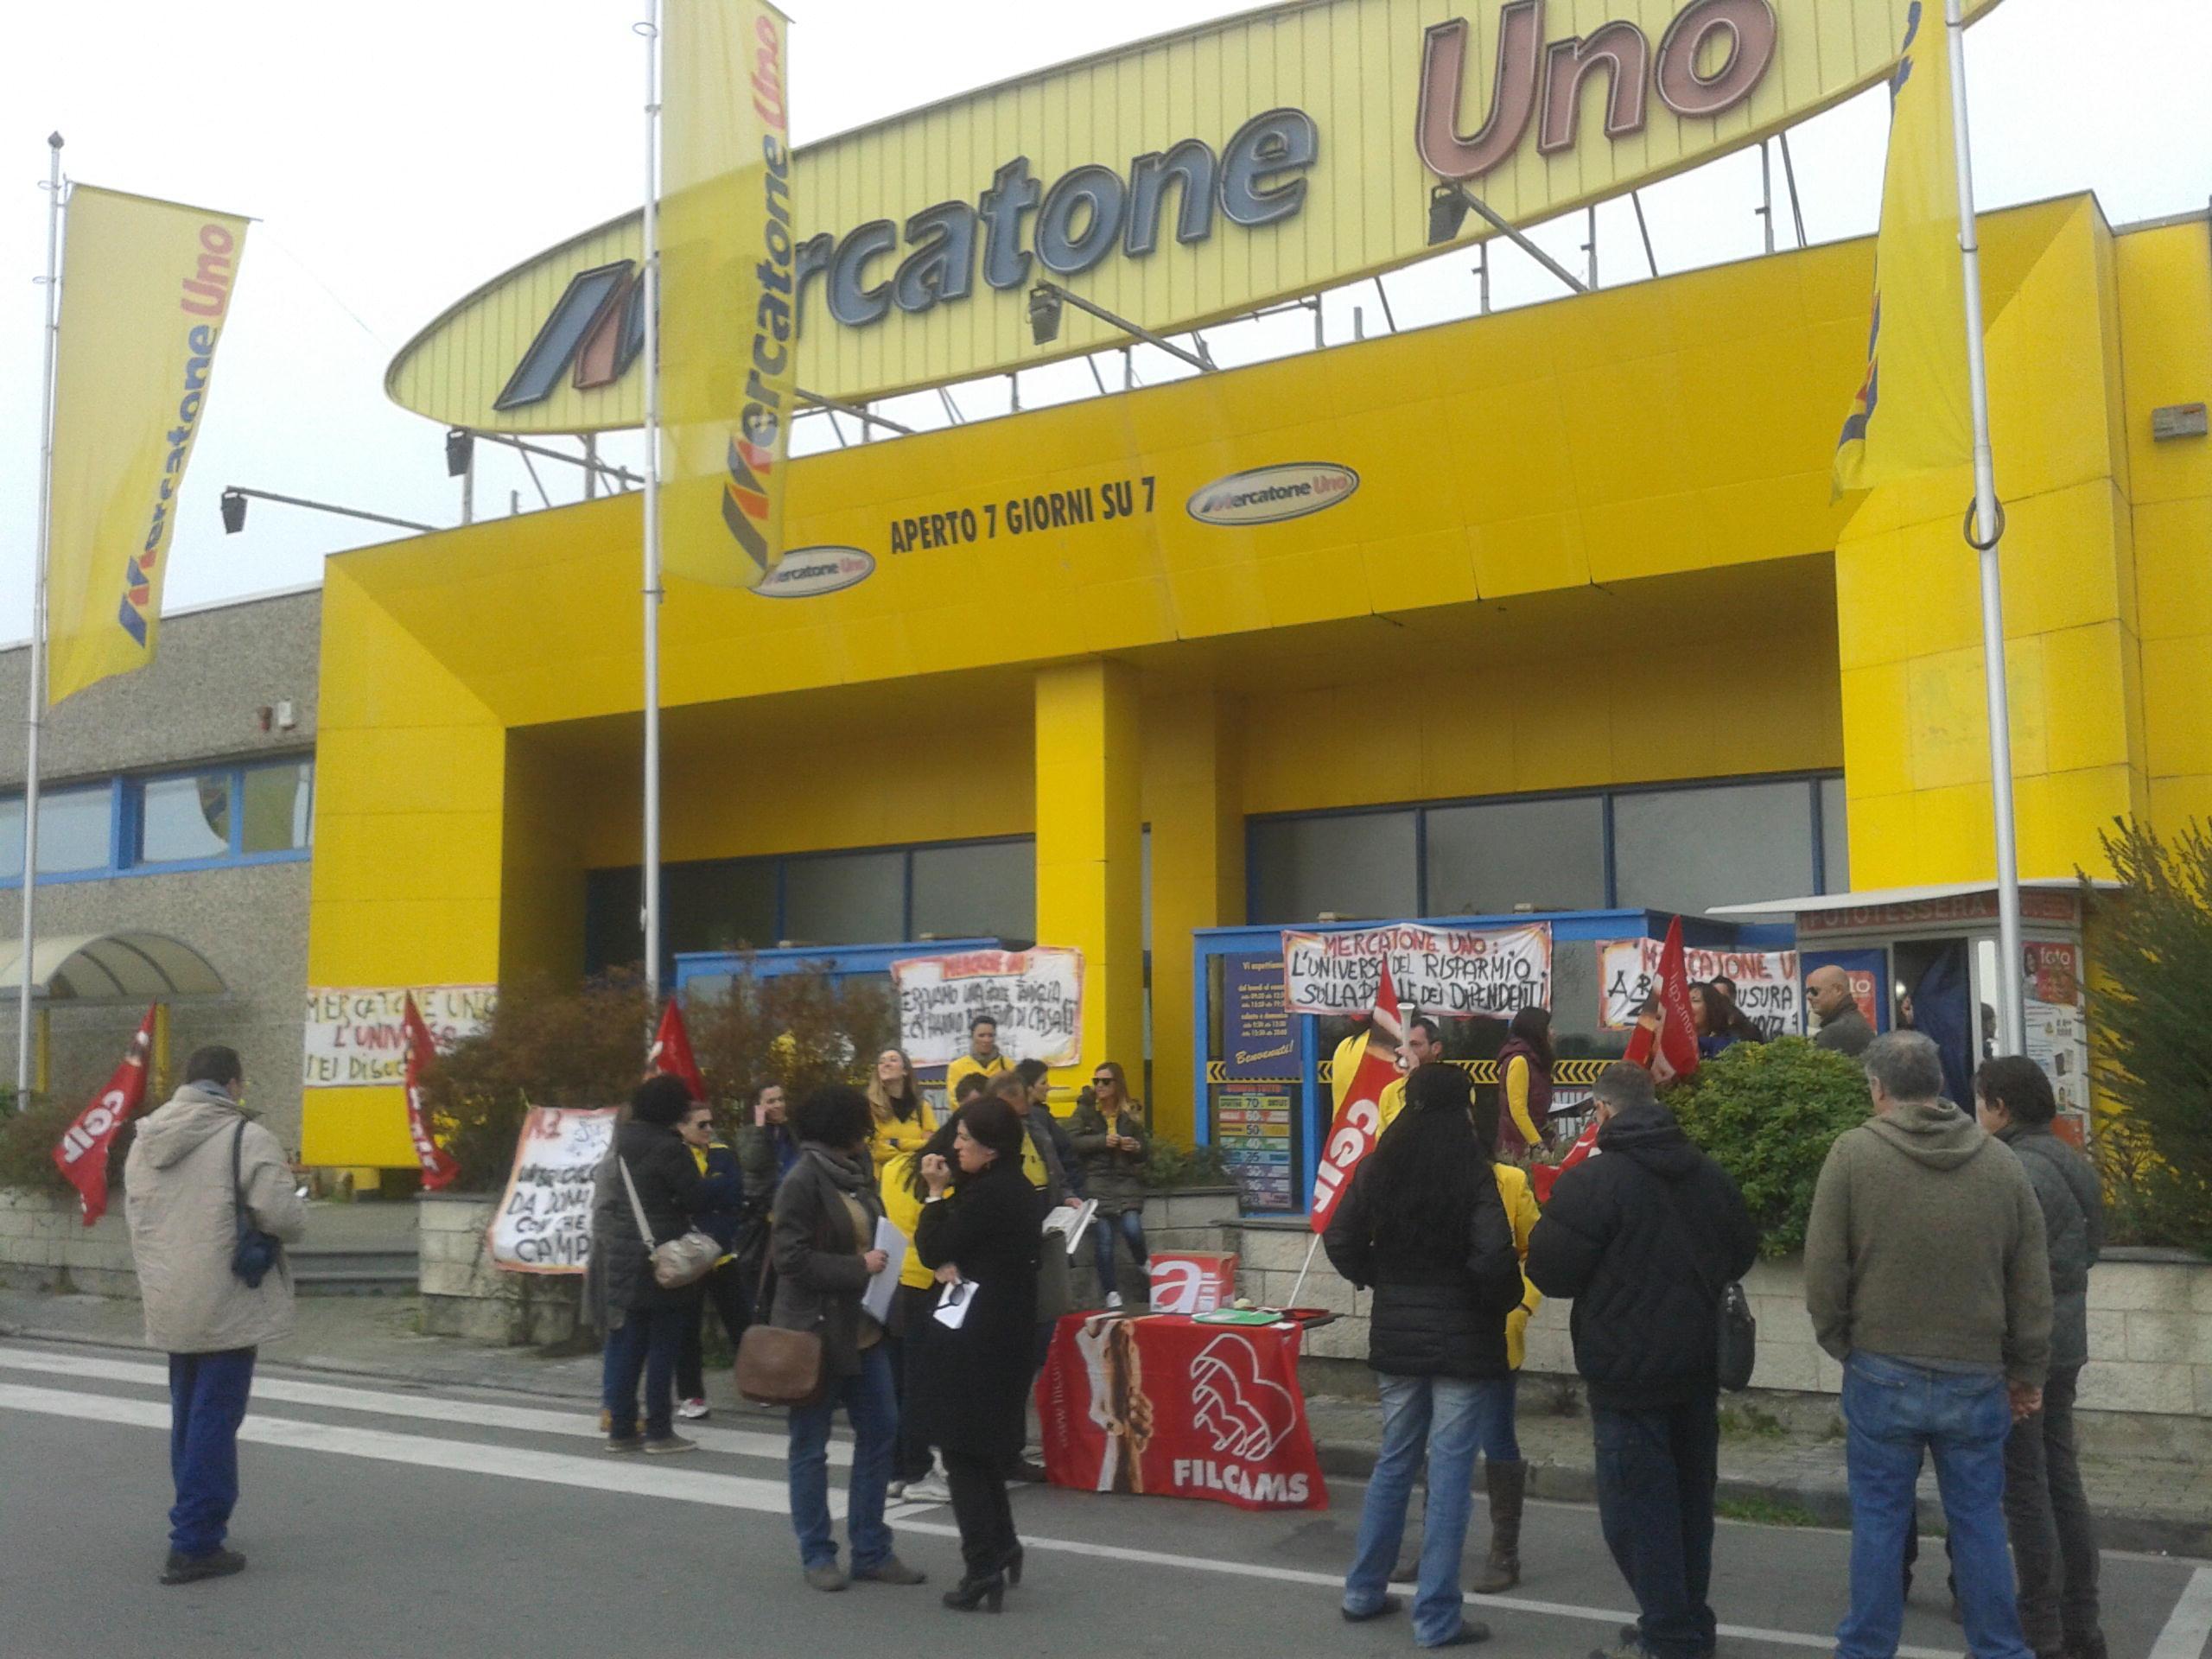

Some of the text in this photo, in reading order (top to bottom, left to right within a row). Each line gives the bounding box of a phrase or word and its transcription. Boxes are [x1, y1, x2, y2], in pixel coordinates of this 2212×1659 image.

[493, 107, 1319, 410] Mrcatone
[1415, 0, 1777, 178] Uno
[721, 16, 791, 570] Mercatone Uno
[118, 223, 234, 649] Mercatone Uno
[891, 476, 1156, 554] APERTO 7 GIORNI SU 7
[1201, 474, 1347, 513] Mercatone Uno
[1808, 895, 1987, 928] FOTOTESSERA
[1323, 929, 1440, 957] MERCATONE
[1391, 954, 1414, 975] DEL
[1426, 950, 1531, 981] RISPARMIO
[1173, 1459, 1310, 1503] FILCAMS
